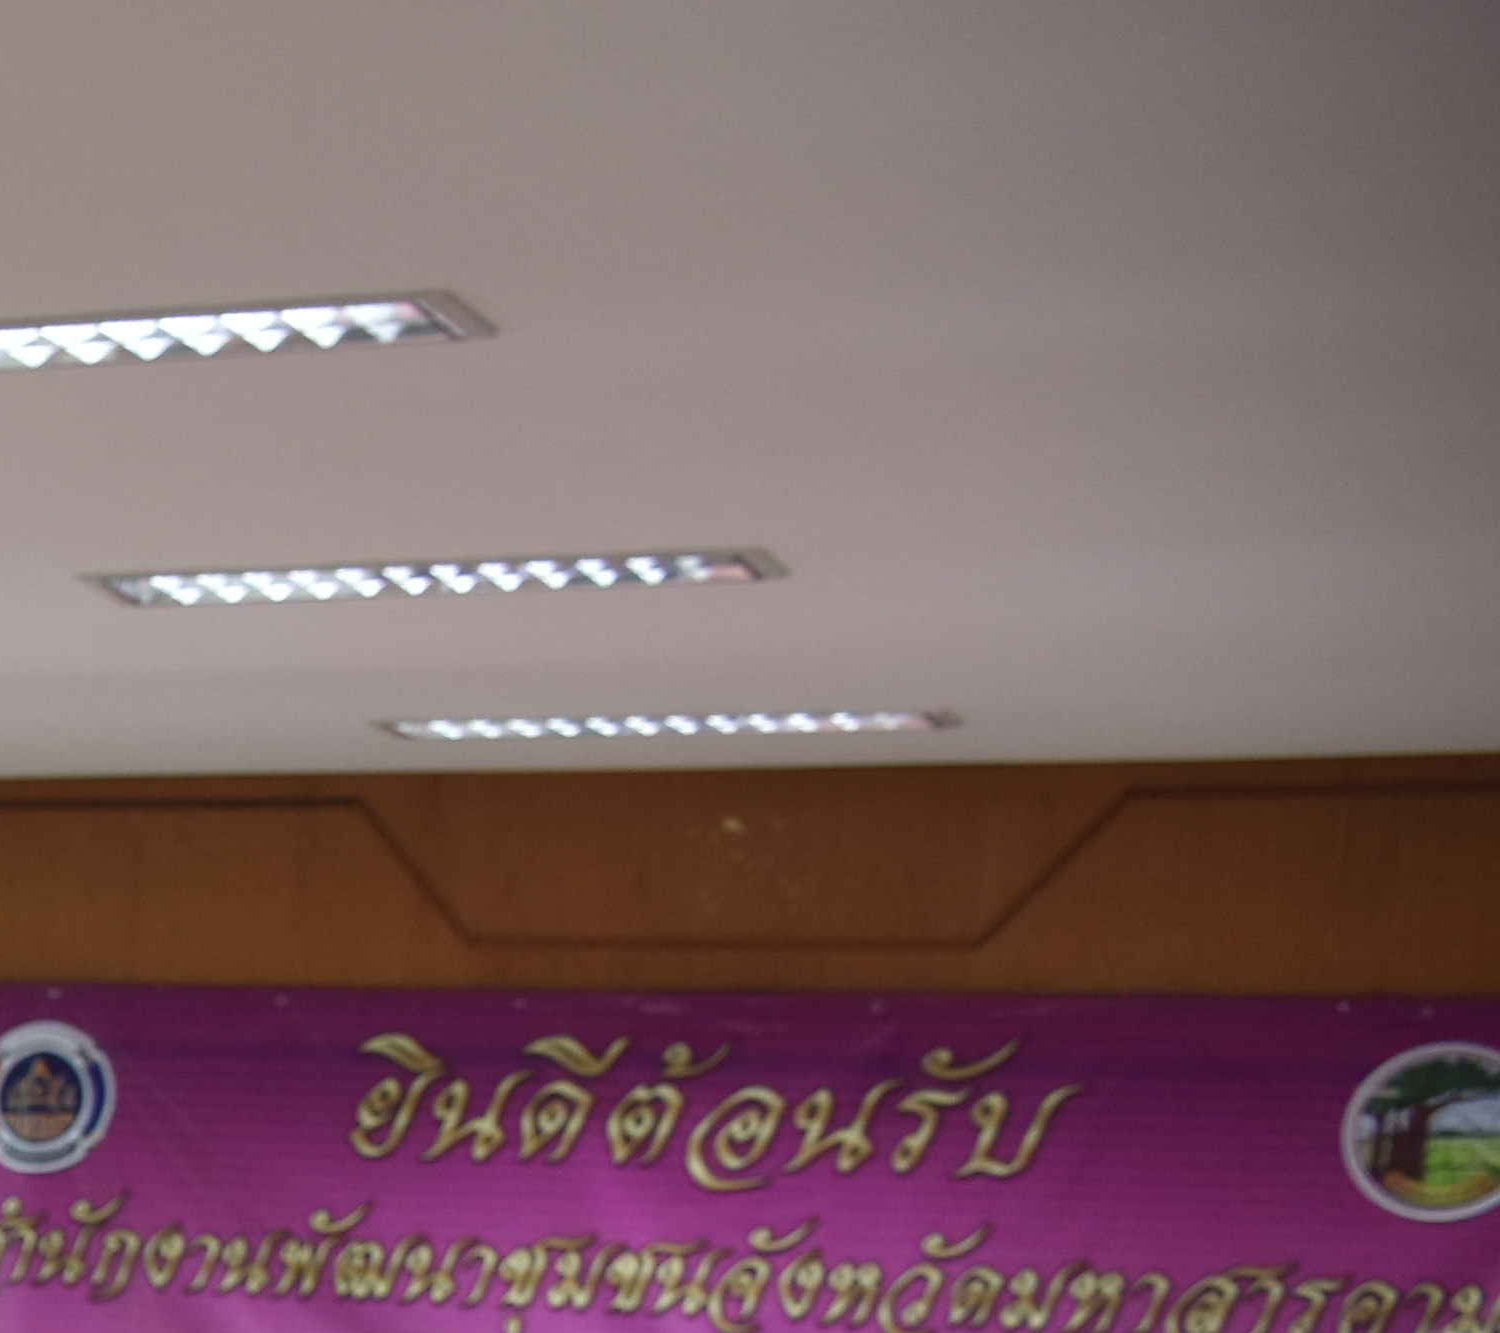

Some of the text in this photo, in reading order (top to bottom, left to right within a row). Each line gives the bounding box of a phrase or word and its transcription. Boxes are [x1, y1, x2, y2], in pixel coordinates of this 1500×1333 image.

[348, 1032, 1084, 1191] ยินดีต้อนรับ
